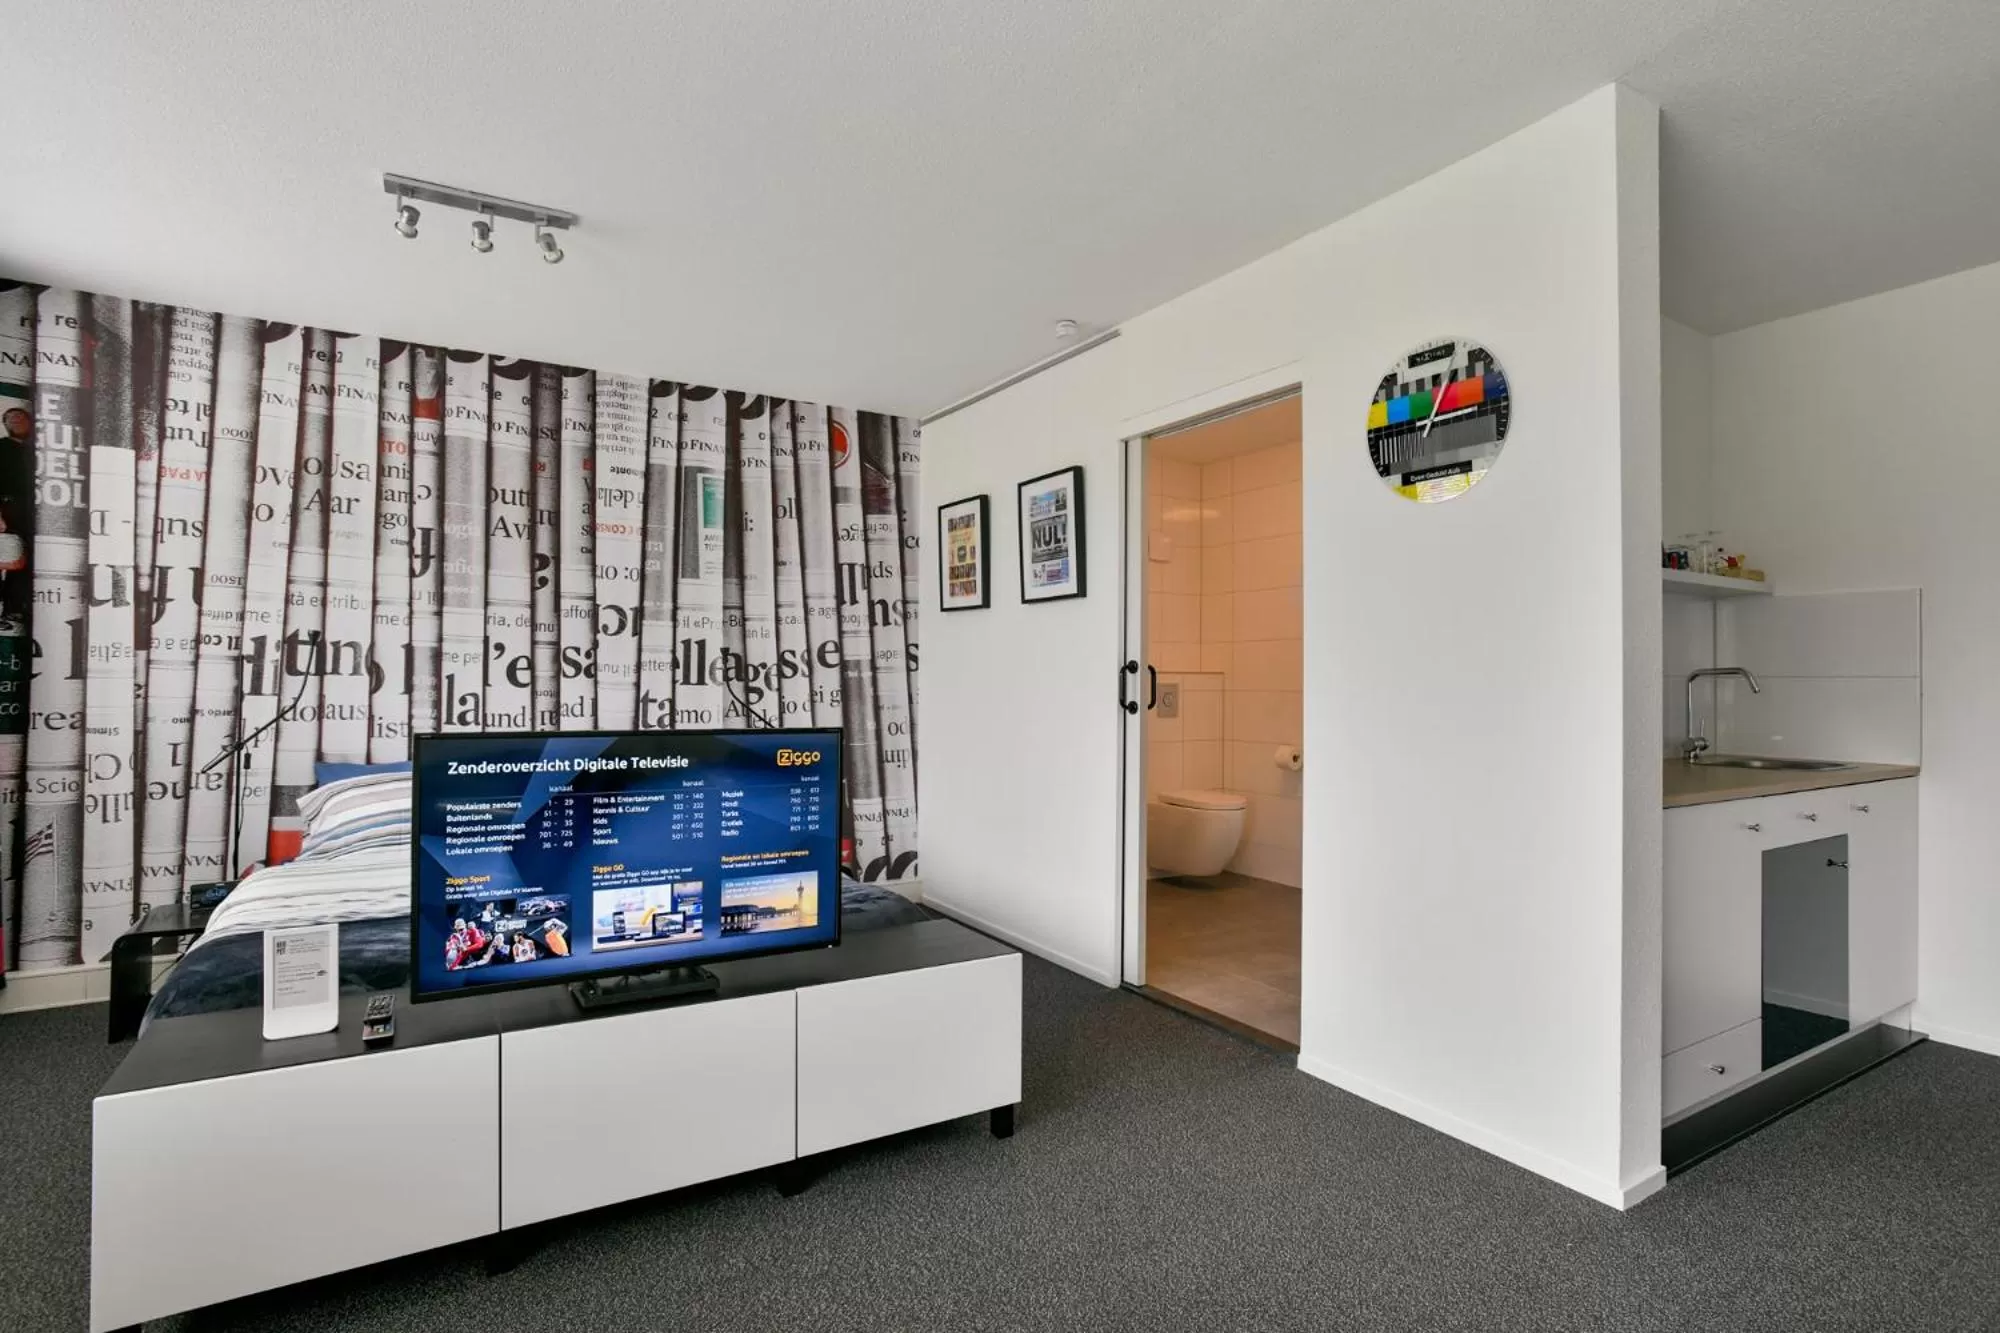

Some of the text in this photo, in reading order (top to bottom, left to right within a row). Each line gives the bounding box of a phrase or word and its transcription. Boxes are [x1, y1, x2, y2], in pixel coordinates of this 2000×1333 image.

[777, 749, 820, 766] Ziggo
[448, 756, 689, 775] Zenderoverzicht Digitale Televisie
[492, 801, 523, 810] zenders
[446, 813, 493, 822] Buitenlands
[446, 824, 486, 834] Regionale
[487, 822, 526, 832] omroepen
[593, 827, 612, 836] Sport
[446, 835, 486, 845] Regionale
[487, 833, 526, 842] omroepen
[446, 846, 473, 856] Lokale
